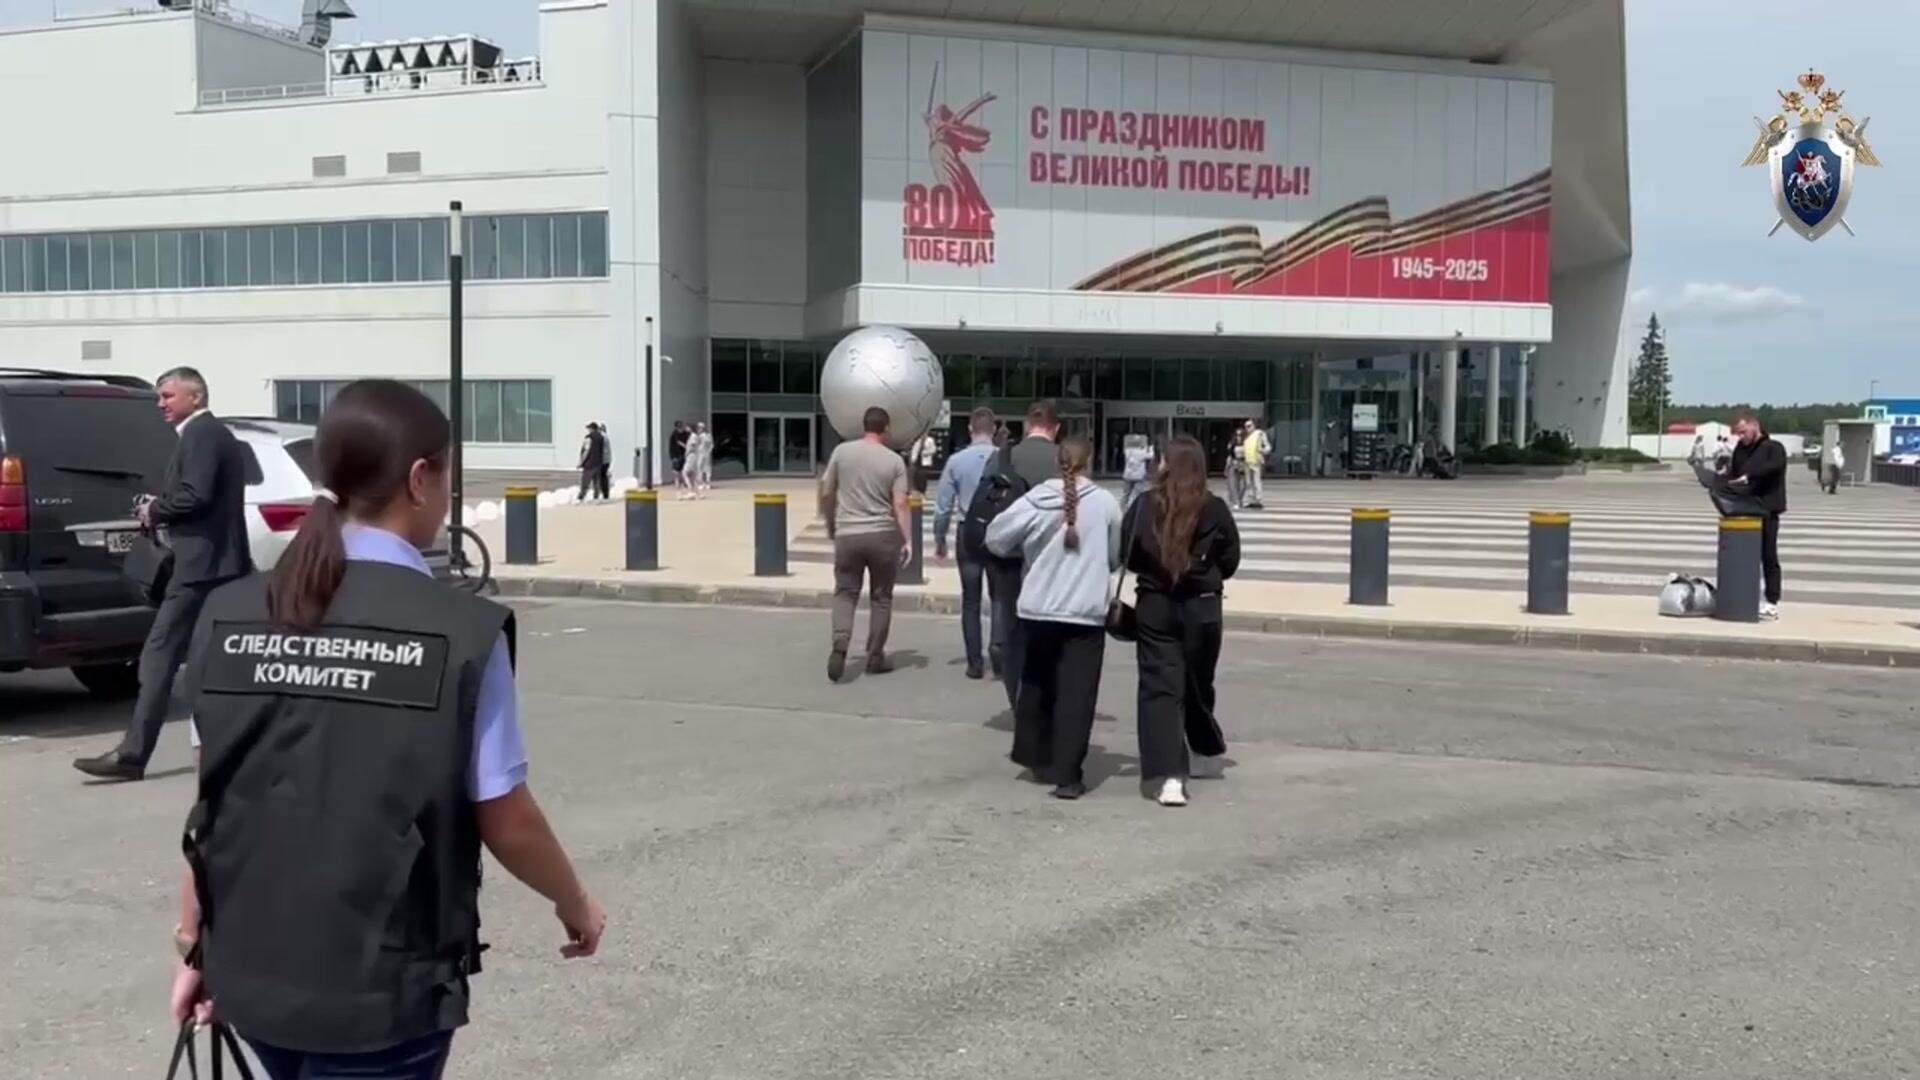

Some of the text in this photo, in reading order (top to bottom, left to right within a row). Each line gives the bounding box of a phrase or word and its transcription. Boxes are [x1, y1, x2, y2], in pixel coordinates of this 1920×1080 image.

[1031, 106, 1265, 152] С ПРАЗДНИКОМ
[1029, 153, 1310, 199] ВЕЛИКОЙ ПОБЕДЫ!
[904, 183, 954, 229] 80
[903, 238, 995, 267] ПОБЕДА!
[223, 634, 425, 666] СЛЕДСТВЕННЫЙ
[253, 662, 376, 691] КОМИТЕТ
